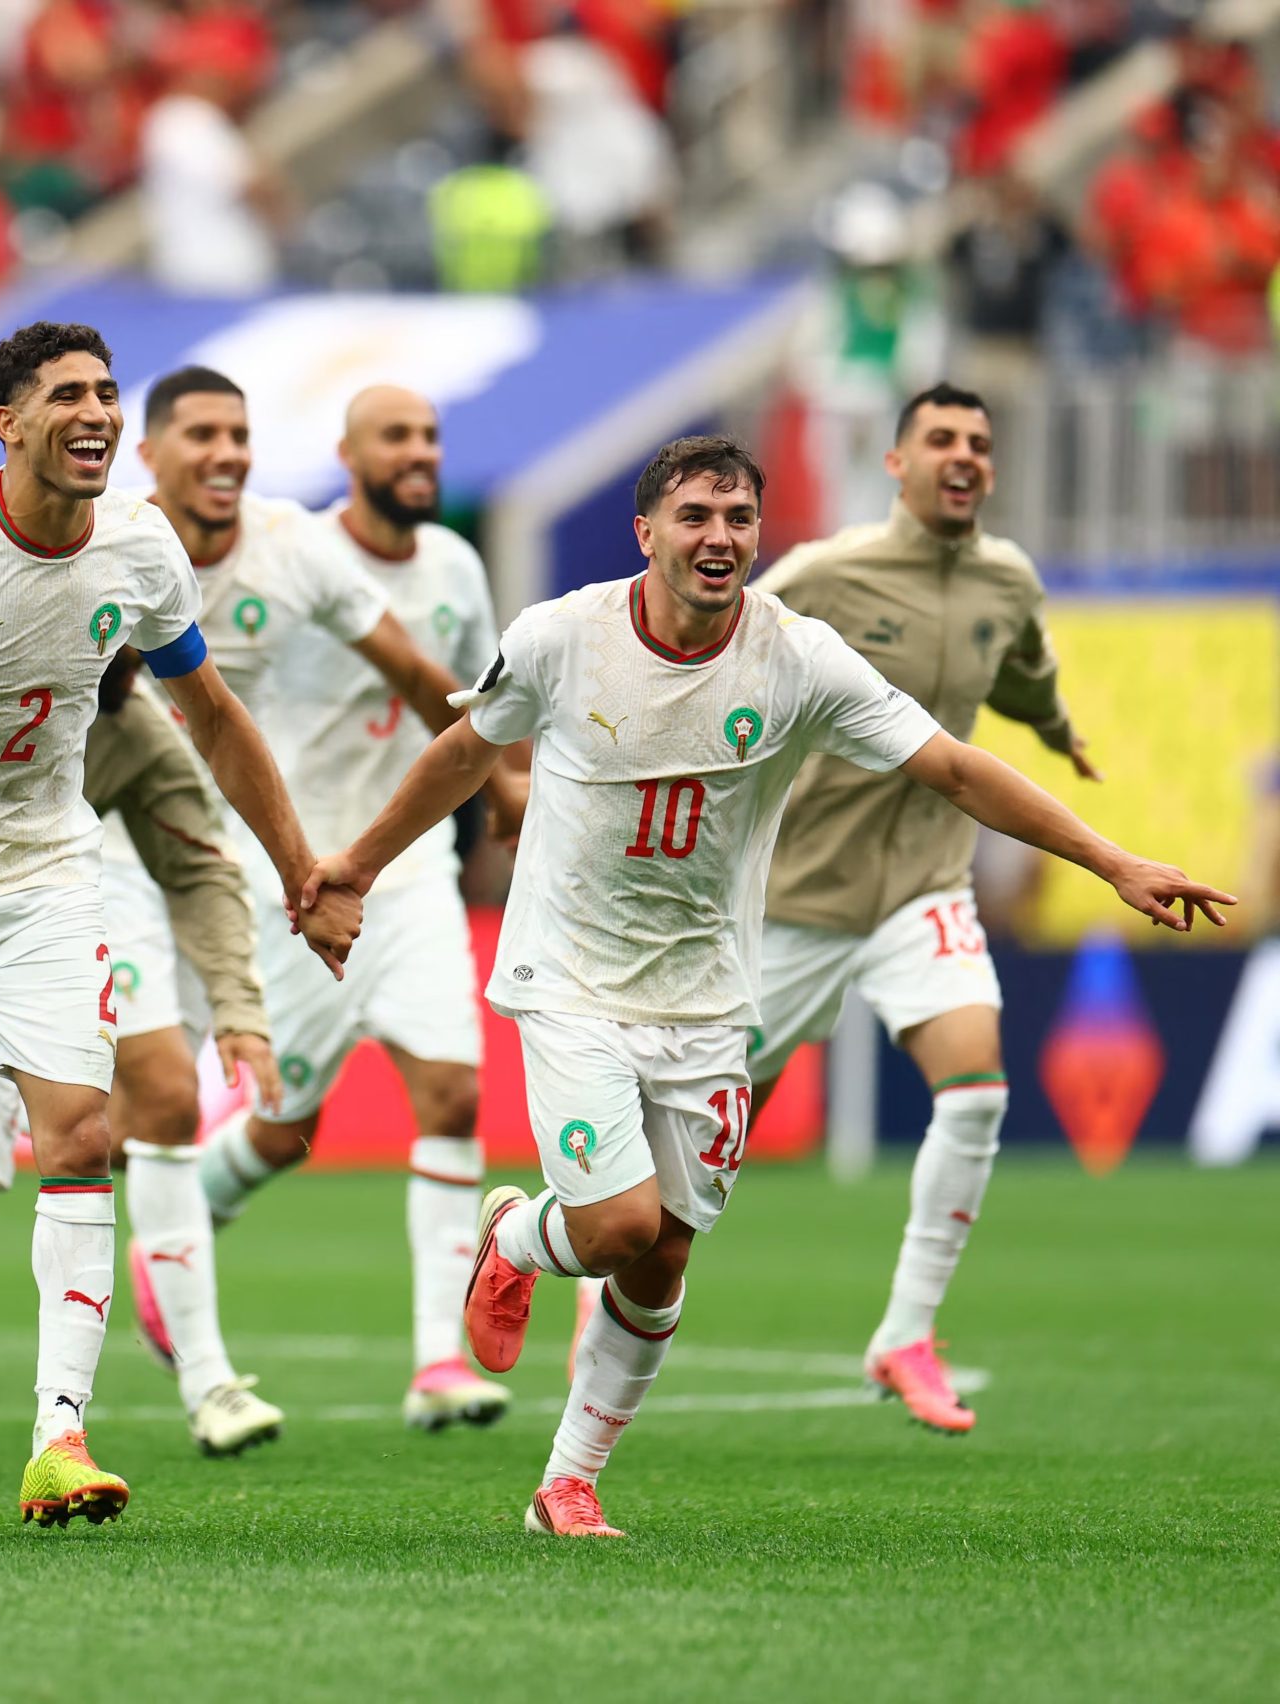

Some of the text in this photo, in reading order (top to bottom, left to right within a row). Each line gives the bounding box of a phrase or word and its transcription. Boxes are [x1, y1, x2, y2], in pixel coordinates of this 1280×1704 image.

[0, 687, 54, 762] 2
[624, 777, 706, 859] 10
[96, 943, 118, 1026] 2
[699, 1086, 751, 1171] 10
